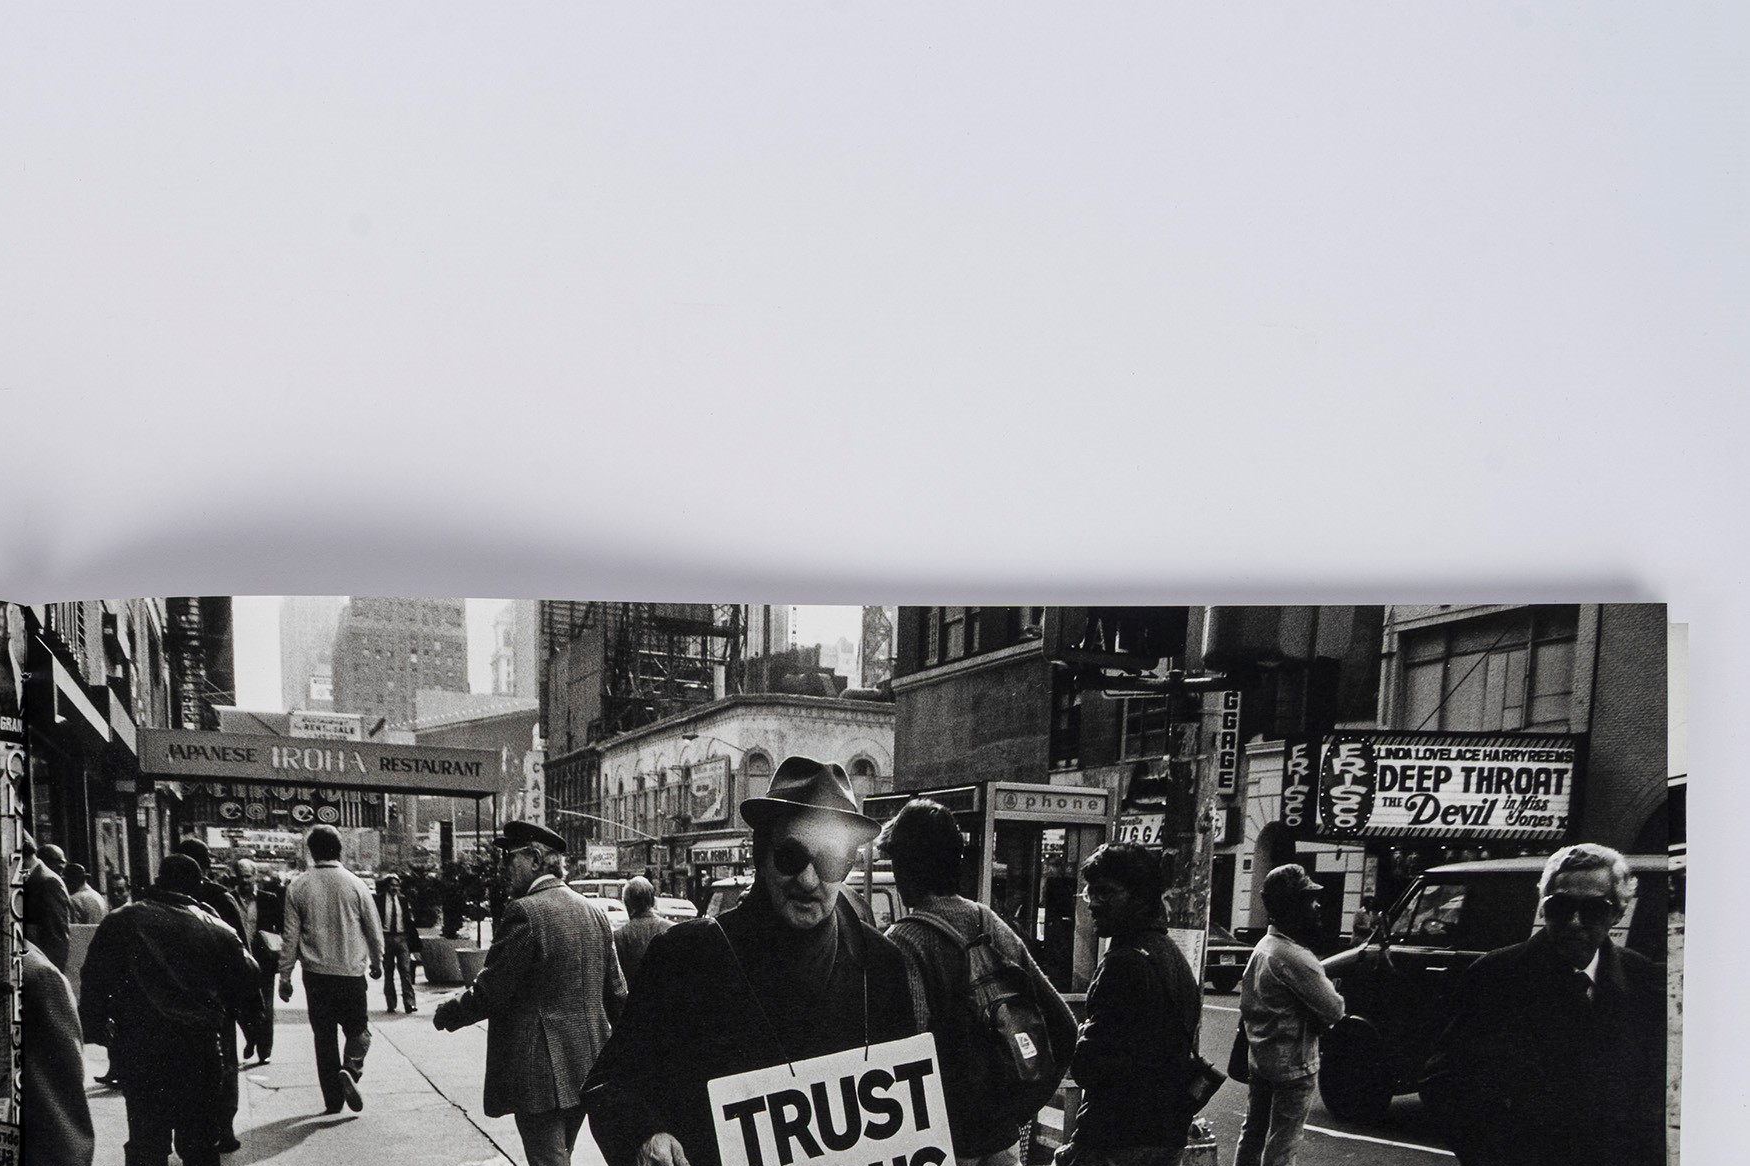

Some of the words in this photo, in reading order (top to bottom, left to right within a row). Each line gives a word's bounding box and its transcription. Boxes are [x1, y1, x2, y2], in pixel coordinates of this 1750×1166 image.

[1218, 691, 1239, 789] GGAGE
[1377, 747, 1413, 760] LINDA
[1415, 748, 1481, 762] LOVELACE
[169, 743, 258, 763] JAPANESE
[271, 746, 368, 774] IROHA
[380, 756, 483, 778] RESTAURANT
[531, 762, 541, 824] CAST
[1283, 743, 1310, 827] FRISCO
[1329, 743, 1369, 828] FRISCO
[1378, 764, 1452, 793] DEEP
[1460, 766, 1569, 796] THROAT
[1025, 794, 1099, 811] phone
[1382, 796, 1403, 808] THE
[1405, 792, 1499, 826] Devil
[1513, 795, 1549, 813] Miss
[1505, 812, 1554, 828] Jones
